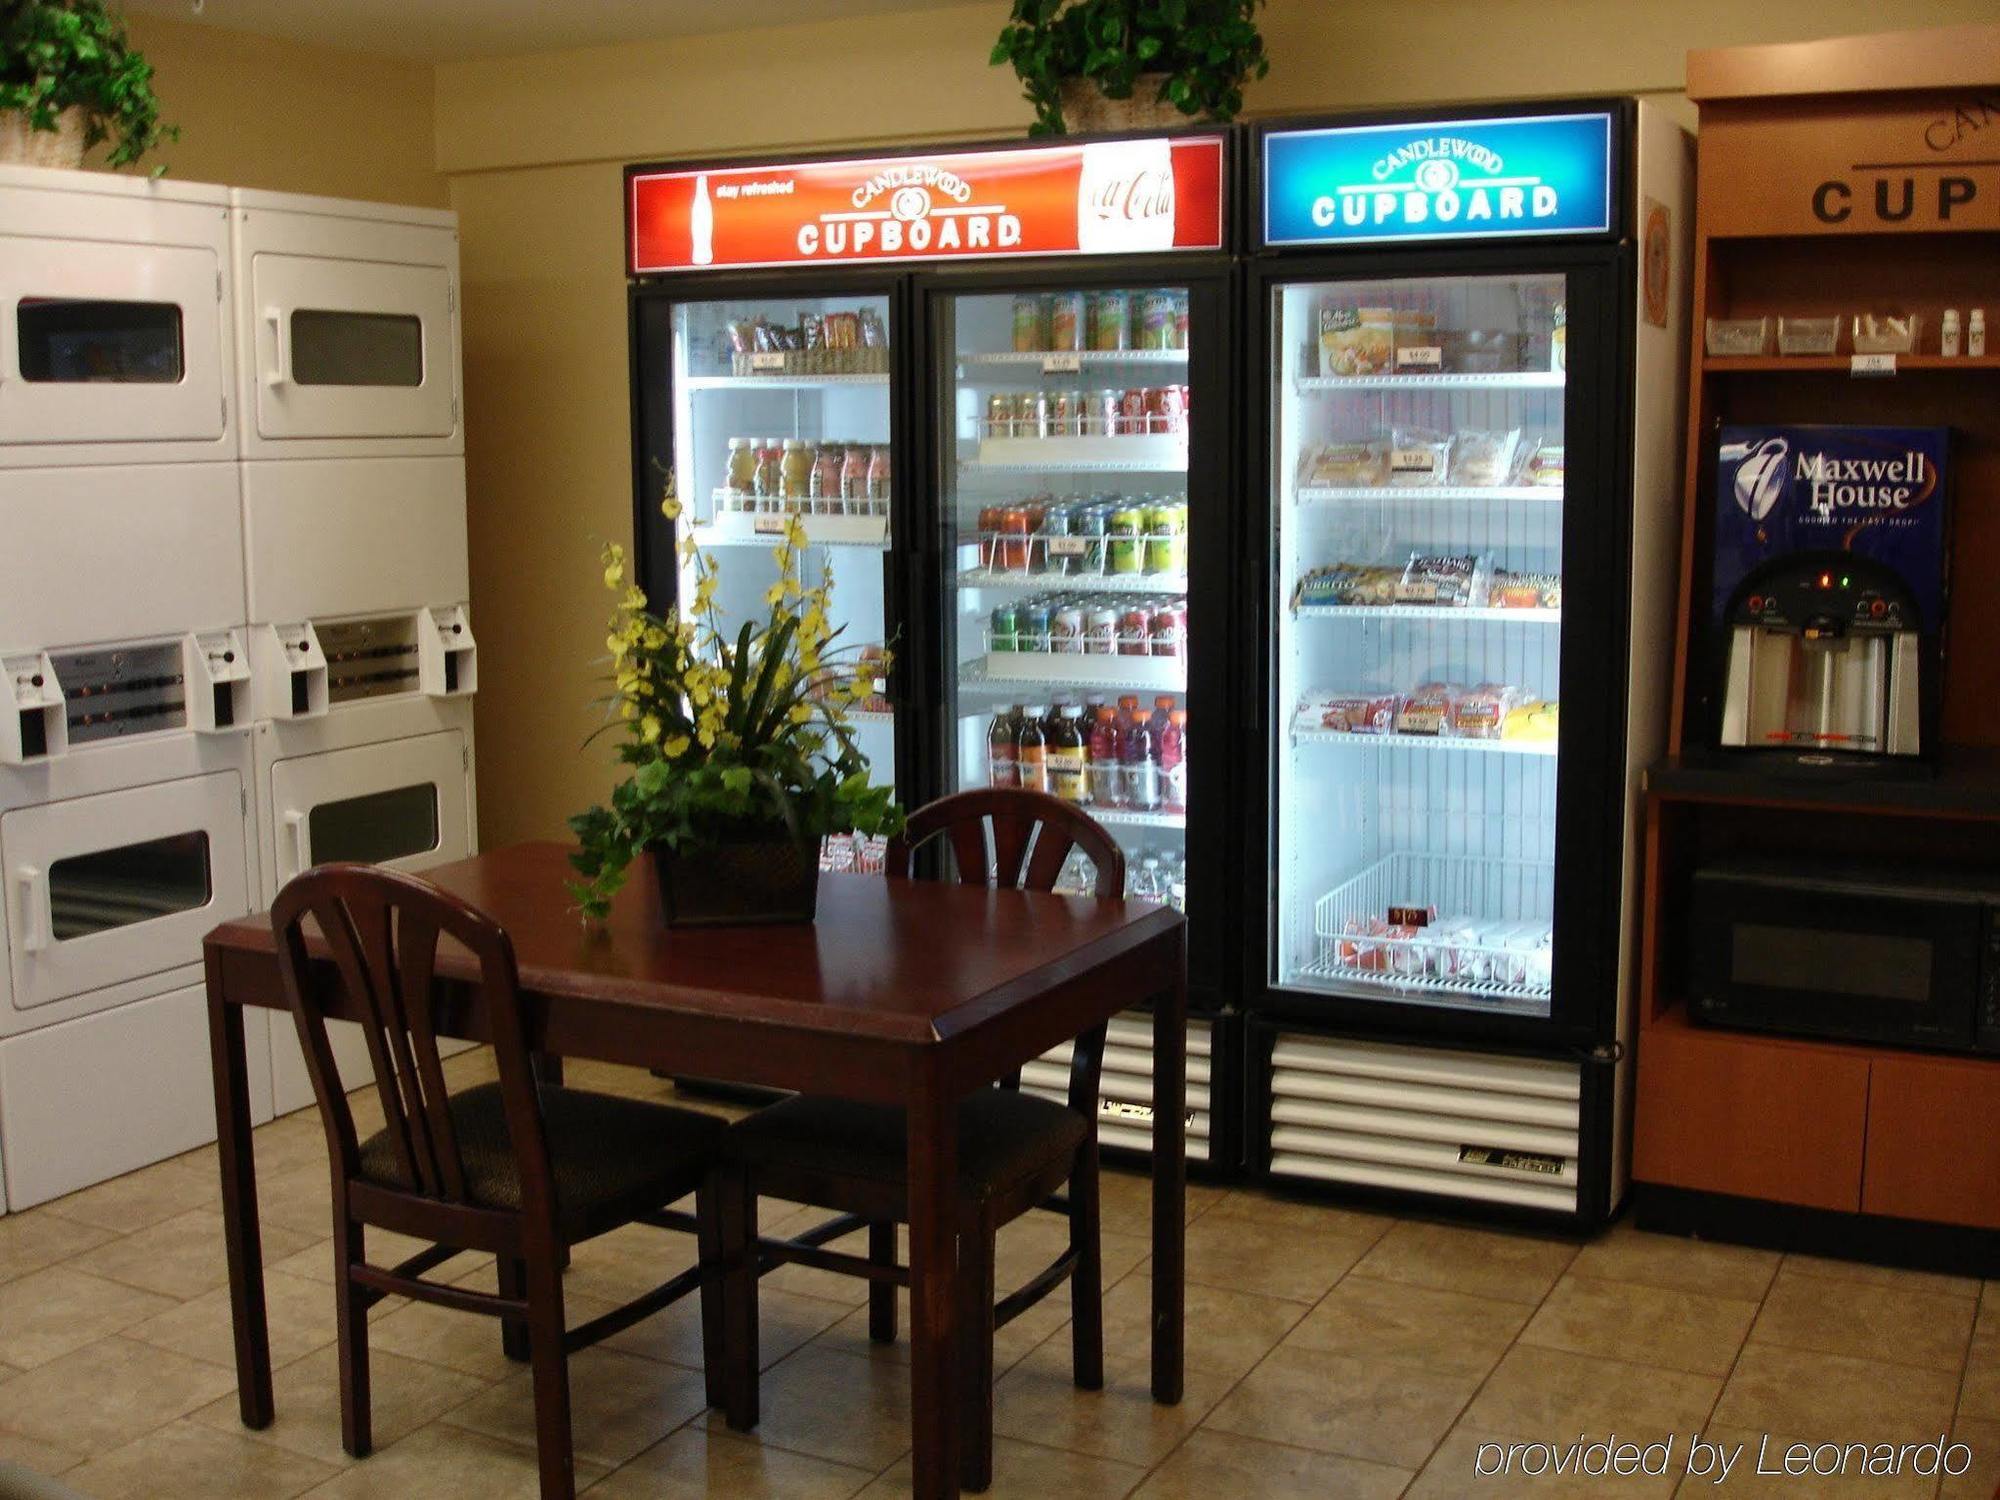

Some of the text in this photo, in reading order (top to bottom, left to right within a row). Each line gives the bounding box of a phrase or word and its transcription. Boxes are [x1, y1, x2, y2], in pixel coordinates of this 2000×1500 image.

[1372, 137, 1503, 181] CANDLEWOOD
[716, 180, 794, 199] stay refreshed
[852, 165, 971, 209] CANDLEWOOD
[1311, 186, 1557, 228] CUPBOARD
[1812, 177, 1977, 223] CUP
[797, 215, 1021, 256] CUPBOARD
[1795, 451, 1925, 482] Maxwell
[1810, 482, 1910, 511] House
